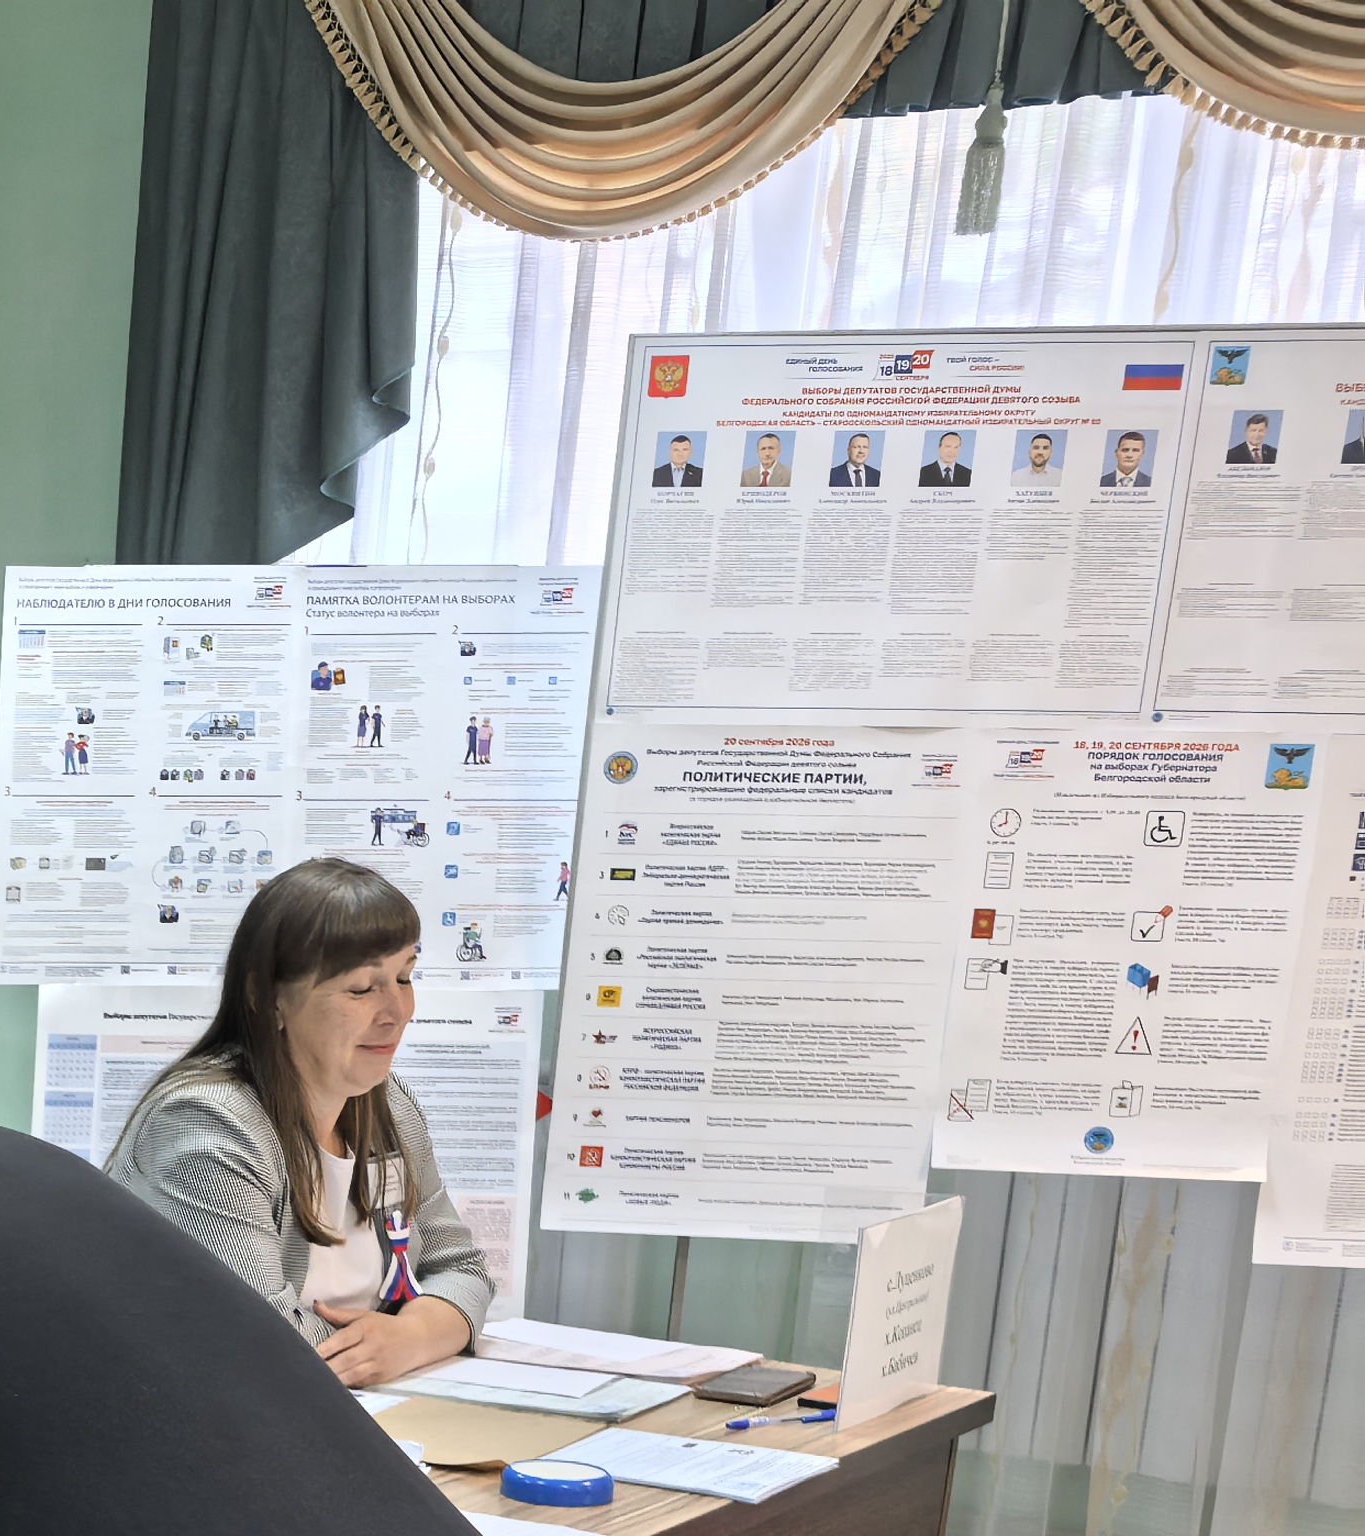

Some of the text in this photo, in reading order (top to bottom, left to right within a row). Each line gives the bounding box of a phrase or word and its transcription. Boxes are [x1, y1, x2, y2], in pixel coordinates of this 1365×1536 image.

[912, 354, 929, 364] 20
[896, 360, 910, 370] 19
[880, 366, 893, 376] 18
[802, 385, 1022, 395] ВЫБОРЫ ДЕПУТАТОВ ГОСУДАРСТВЕННОЙ ДУМЫ
[741, 398, 814, 406] ФЕДЕРАЛЬНОГО
[17, 598, 231, 609] НАБЛЮДАТЕЛЮ В ДНИ ГОЛОСОВАНИЯ
[306, 595, 516, 605] ПАМЯТКА ВОЛОНТЕРАМ НА ВЫБОРАХ
[306, 608, 335, 619] Статус
[337, 610, 385, 619] волонтера
[157, 616, 164, 626] 2
[451, 625, 459, 635] 2
[724, 737, 737, 746] 20
[786, 738, 810, 746] 2026
[812, 739, 835, 747] года
[1124, 742, 1181, 751] СЕНТЯБРЯ
[1182, 743, 1208, 751] 2026
[1211, 743, 1240, 752] ГОДА
[1087, 752, 1224, 762] ПОРЯДОК ГОЛОСОВАНИЯ
[1105, 763, 1149, 771] выборах
[1151, 764, 1217, 773] Губернатора
[682, 771, 867, 786] ПОЛИТИЧЕСКИЕ ПАРТИИ,
[1094, 773, 1211, 784] Белгородской области
